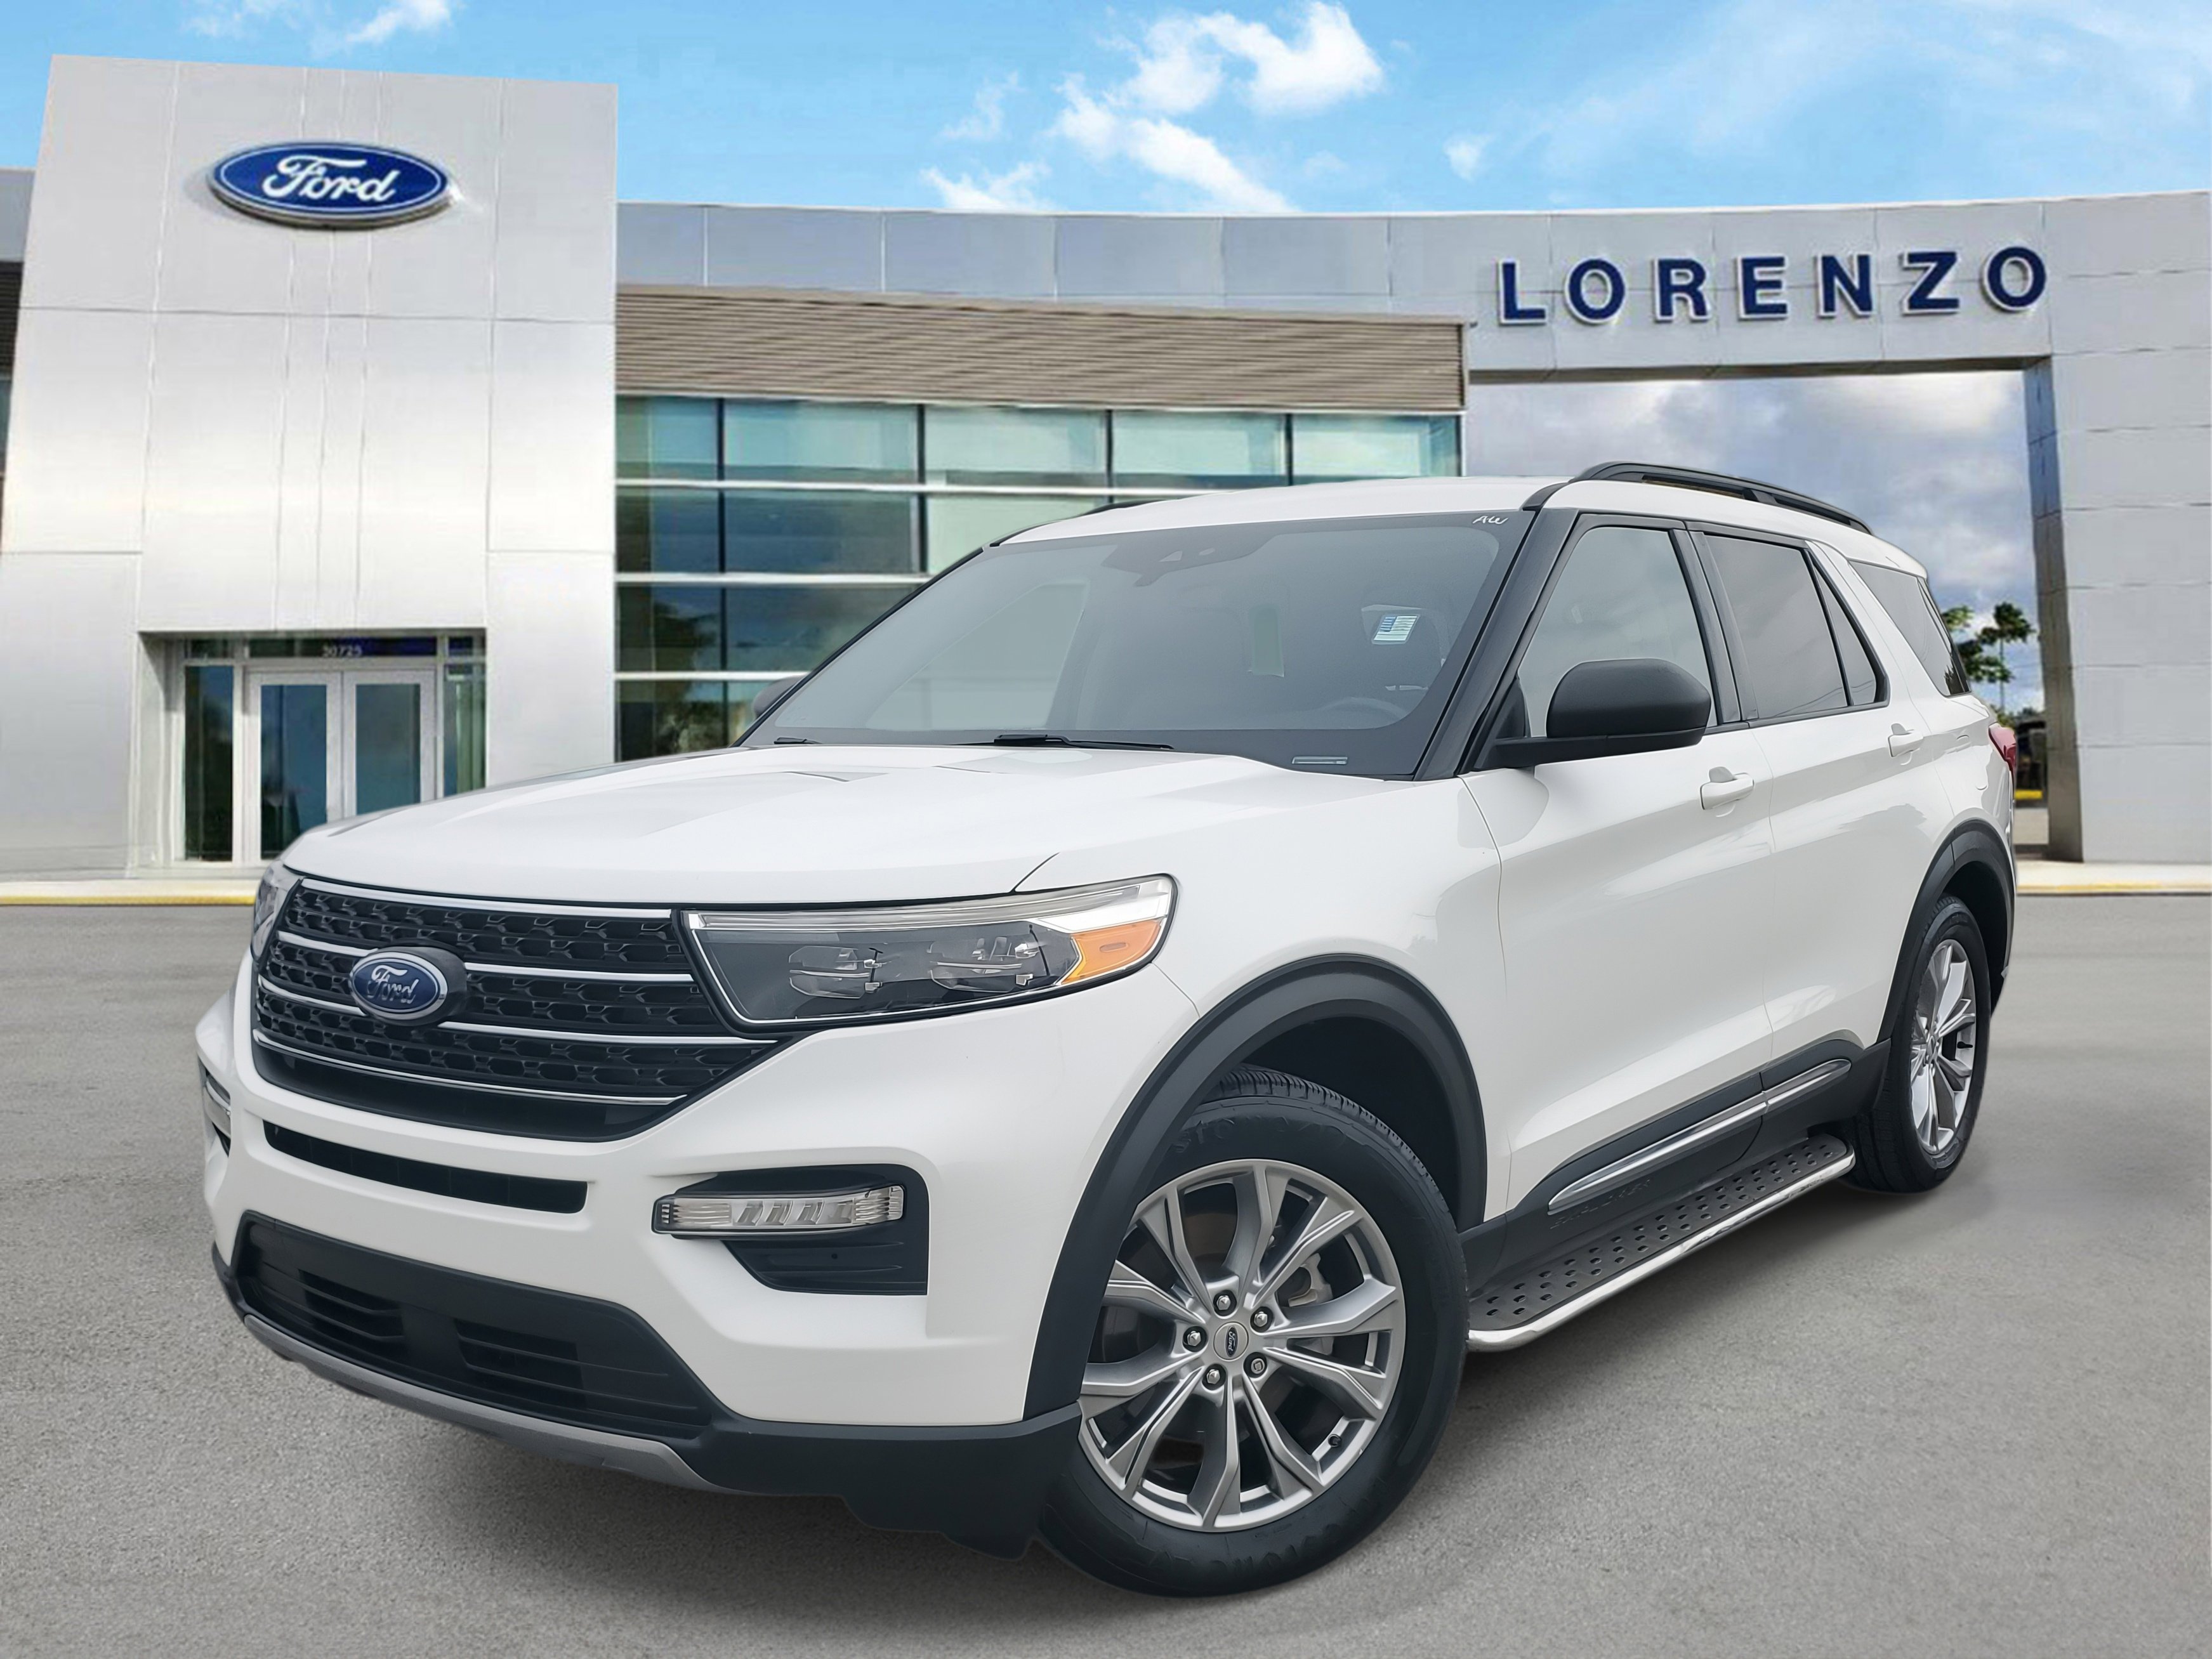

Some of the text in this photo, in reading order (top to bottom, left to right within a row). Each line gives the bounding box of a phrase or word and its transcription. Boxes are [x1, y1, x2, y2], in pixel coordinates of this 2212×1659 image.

[263, 155, 400, 201] Ford
[1498, 246, 2046, 323] LORENZO
[367, 965, 419, 1004] Ford
[1228, 1331, 1236, 1351] Ford
